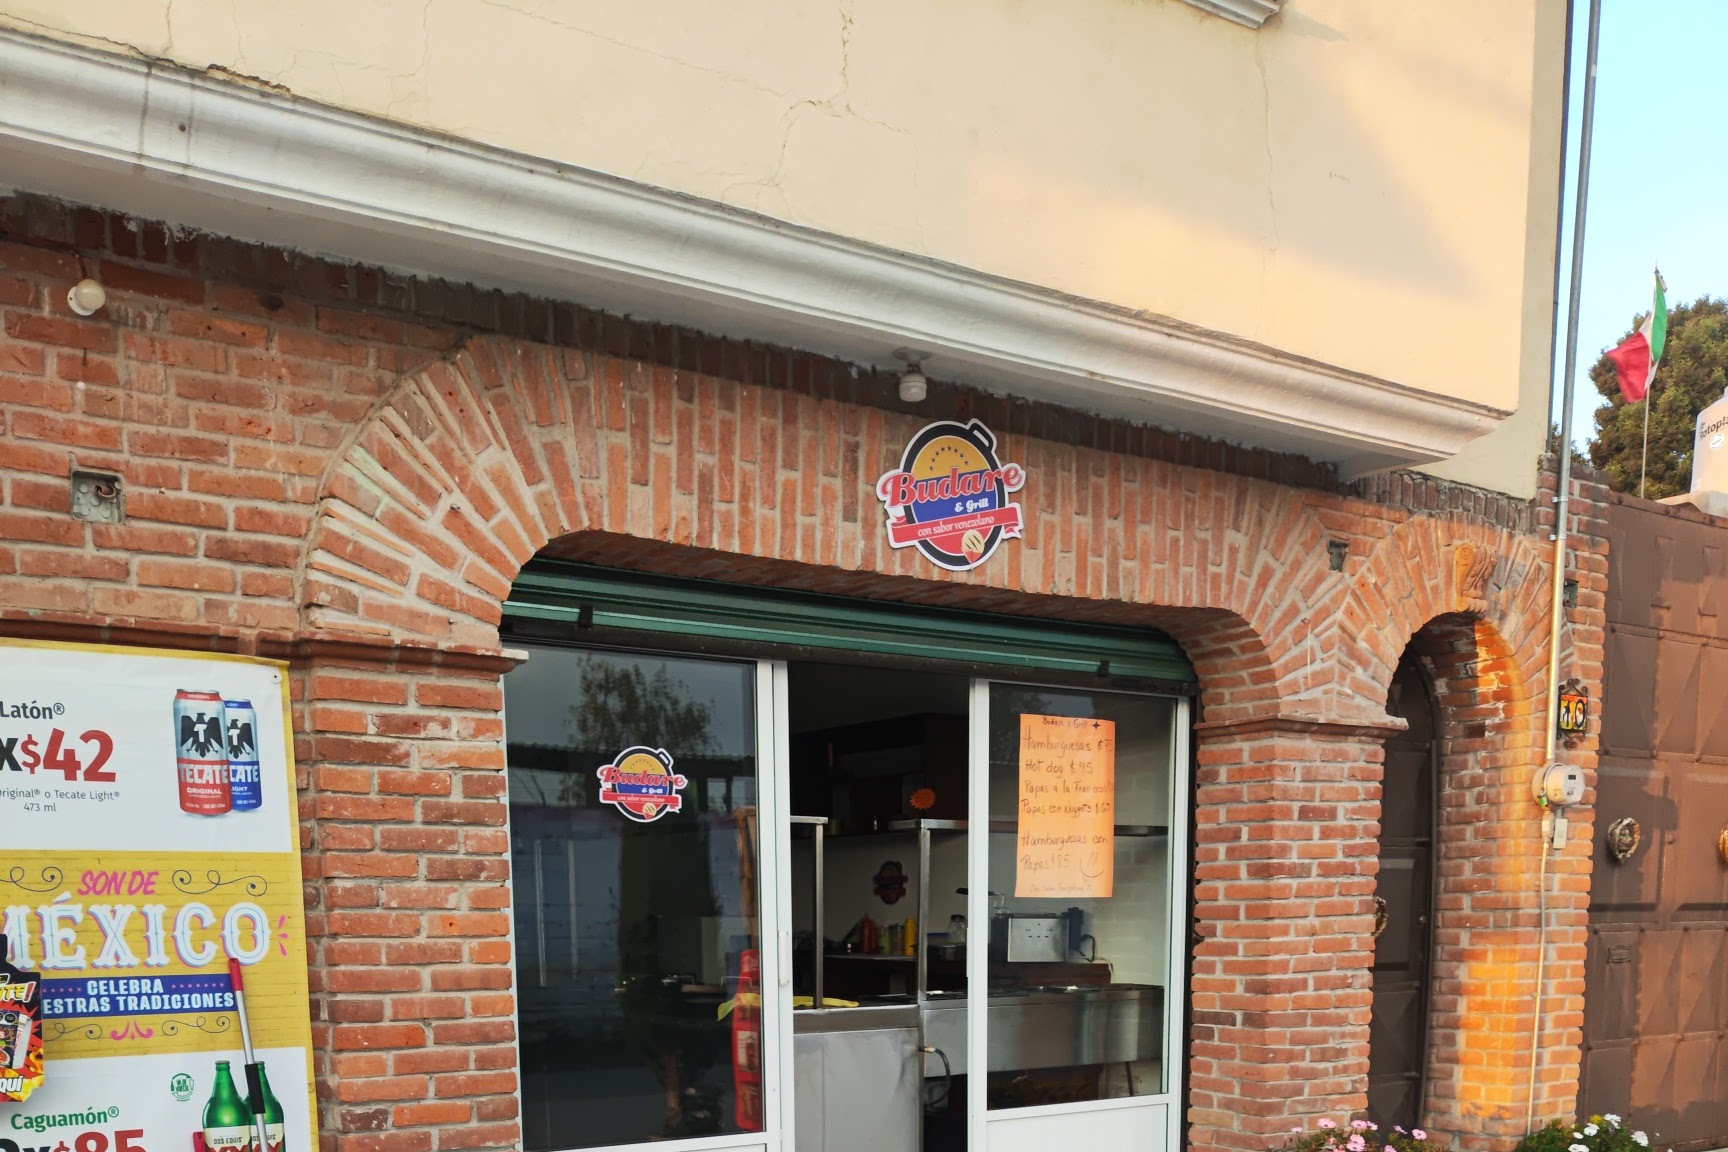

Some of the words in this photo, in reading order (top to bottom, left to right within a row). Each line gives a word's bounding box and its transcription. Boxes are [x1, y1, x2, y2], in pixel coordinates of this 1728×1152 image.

[881, 466, 1023, 507] Budare
[954, 502, 964, 512] &
[966, 498, 989, 513] Grill
[918, 527, 932, 537] con
[933, 520, 954, 534] sabor
[954, 514, 994, 530] venezolano
[1563, 698, 1586, 730] 10
[1023, 725, 1091, 758] Hamburguesas
[178, 763, 230, 785] TECATE
[600, 767, 685, 787] Budare
[1026, 759, 1044, 772] Hot
[1046, 759, 1064, 779] dog
[0, 788, 40, 800] riginal®
[54, 790, 86, 799] Tecate
[89, 791, 120, 802] Light®
[187, 787, 222, 795] ORIGINAL
[1024, 780, 1049, 798] Papas
[24, 803, 40, 811] 473
[44, 803, 56, 811] ml
[1021, 799, 1046, 815] Papas
[1021, 828, 1087, 850] Hamburguesas
[1021, 855, 1049, 872] Papas
[77, 870, 126, 896] SON
[127, 870, 160, 895] DE
[86, 979, 164, 996] CELEBRA
[116, 992, 235, 1012] TRADICIONES
[10, 1106, 120, 1133] Caguamón®
